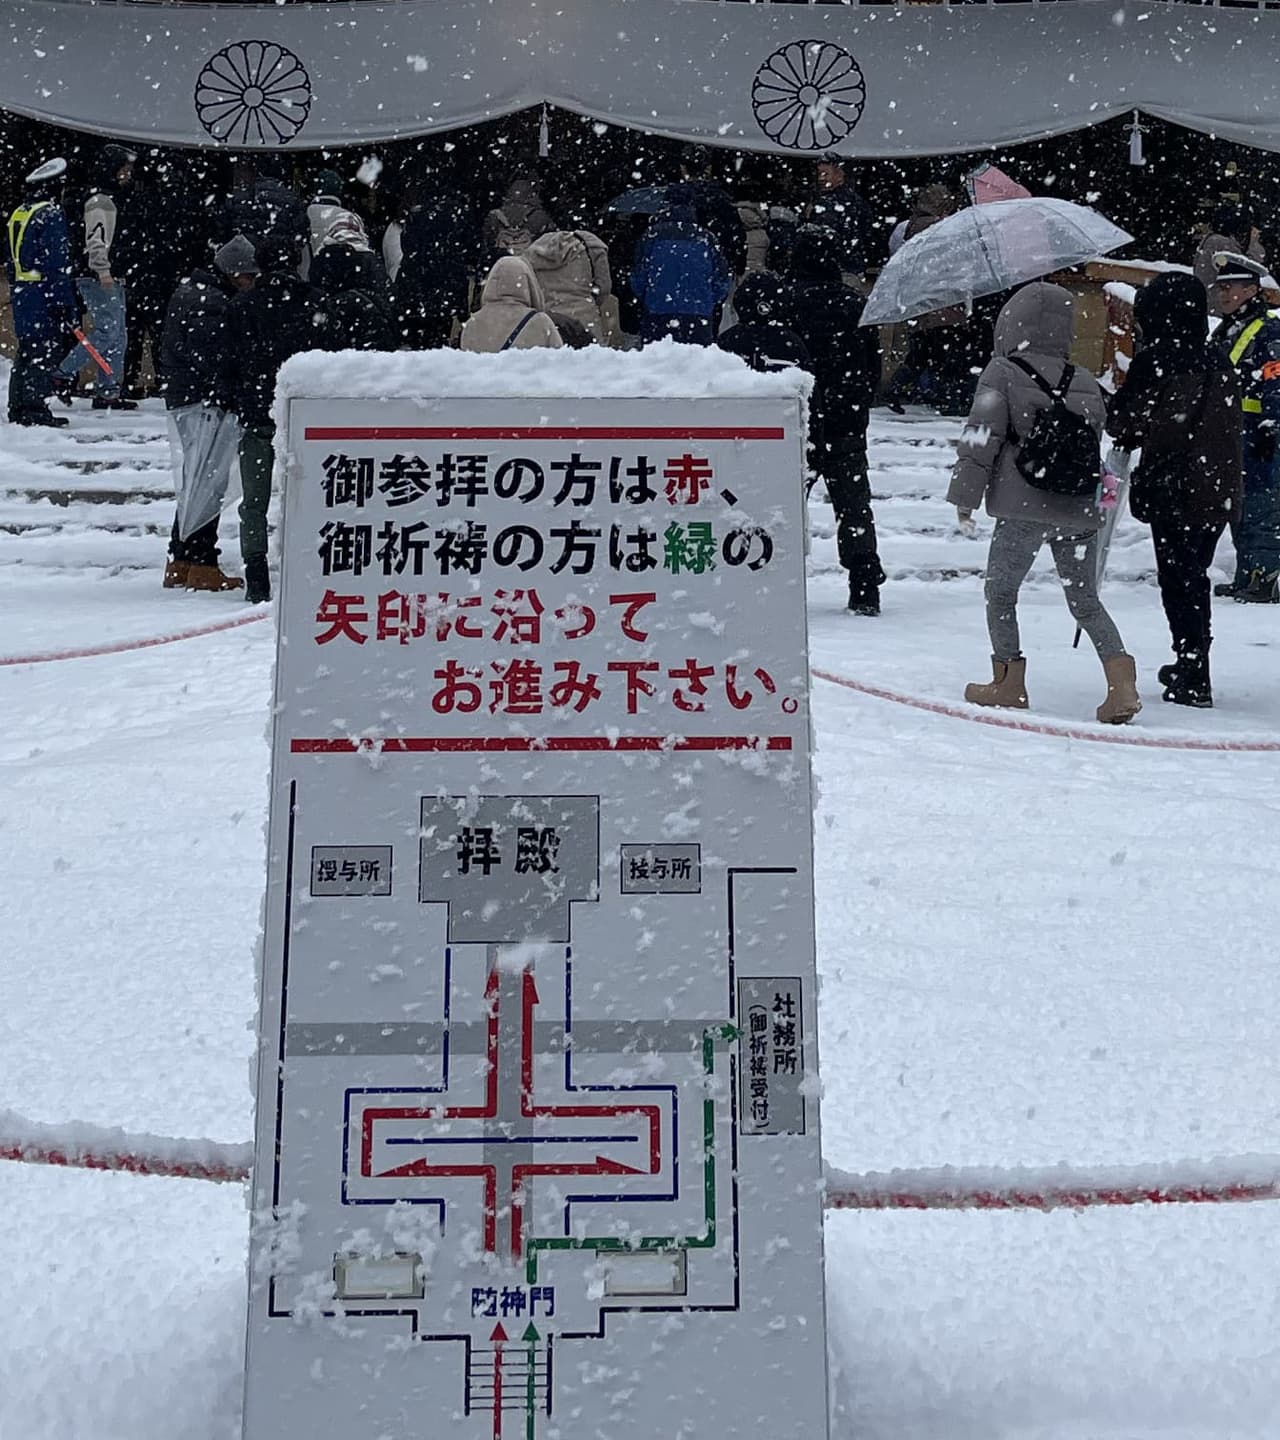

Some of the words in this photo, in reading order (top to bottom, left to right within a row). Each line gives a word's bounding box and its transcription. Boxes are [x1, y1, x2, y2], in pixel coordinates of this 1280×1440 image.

[321, 453, 738, 508] 御参拝の方は赤、
[317, 520, 774, 577] 御祈祷の方は緑の
[314, 588, 657, 645] 矢印に沿って
[431, 658, 799, 715] お進み下さい。
[457, 826, 562, 876] 拝殿
